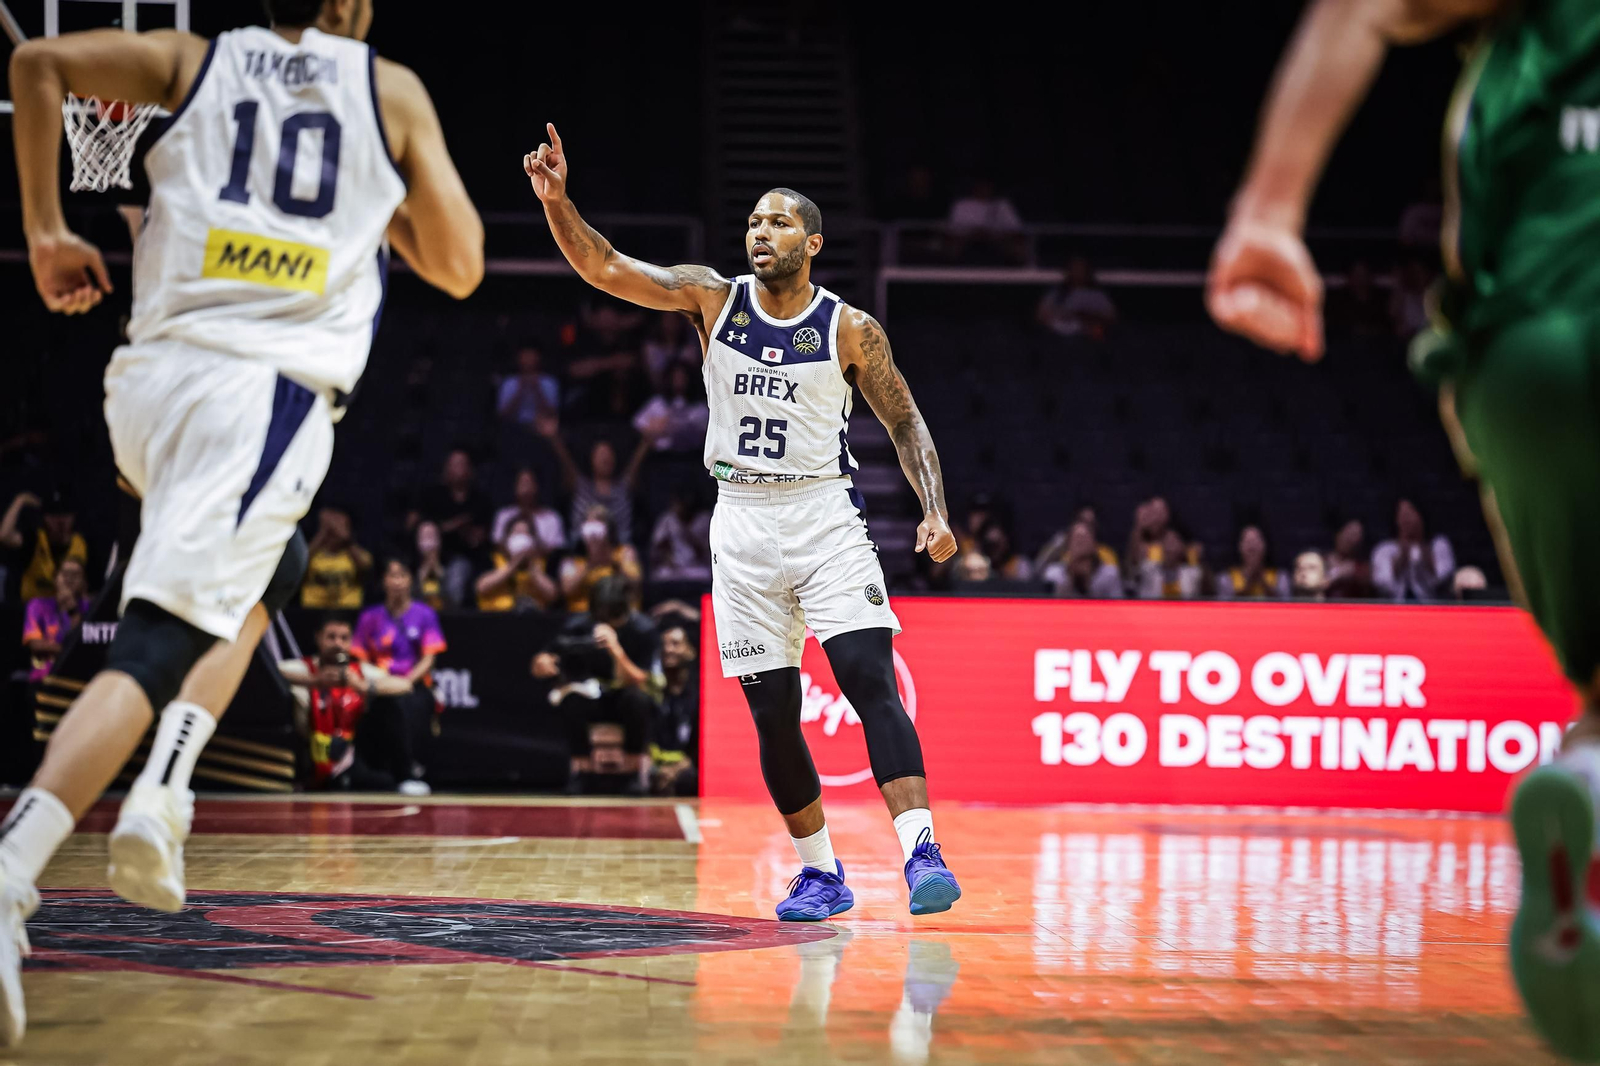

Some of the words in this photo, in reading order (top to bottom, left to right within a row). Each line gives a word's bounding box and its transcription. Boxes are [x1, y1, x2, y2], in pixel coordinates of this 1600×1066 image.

[219, 99, 341, 218] 10
[216, 241, 314, 281] MANI
[733, 373, 799, 404] BREX
[747, 366, 788, 378] UTSUNOMIYA
[737, 415, 788, 460] 25
[721, 644, 766, 660] NICIGAS
[1034, 648, 1142, 702] FLY
[1149, 650, 1241, 704] TO
[1251, 652, 1427, 708] OVER
[1032, 712, 1147, 766] 130
